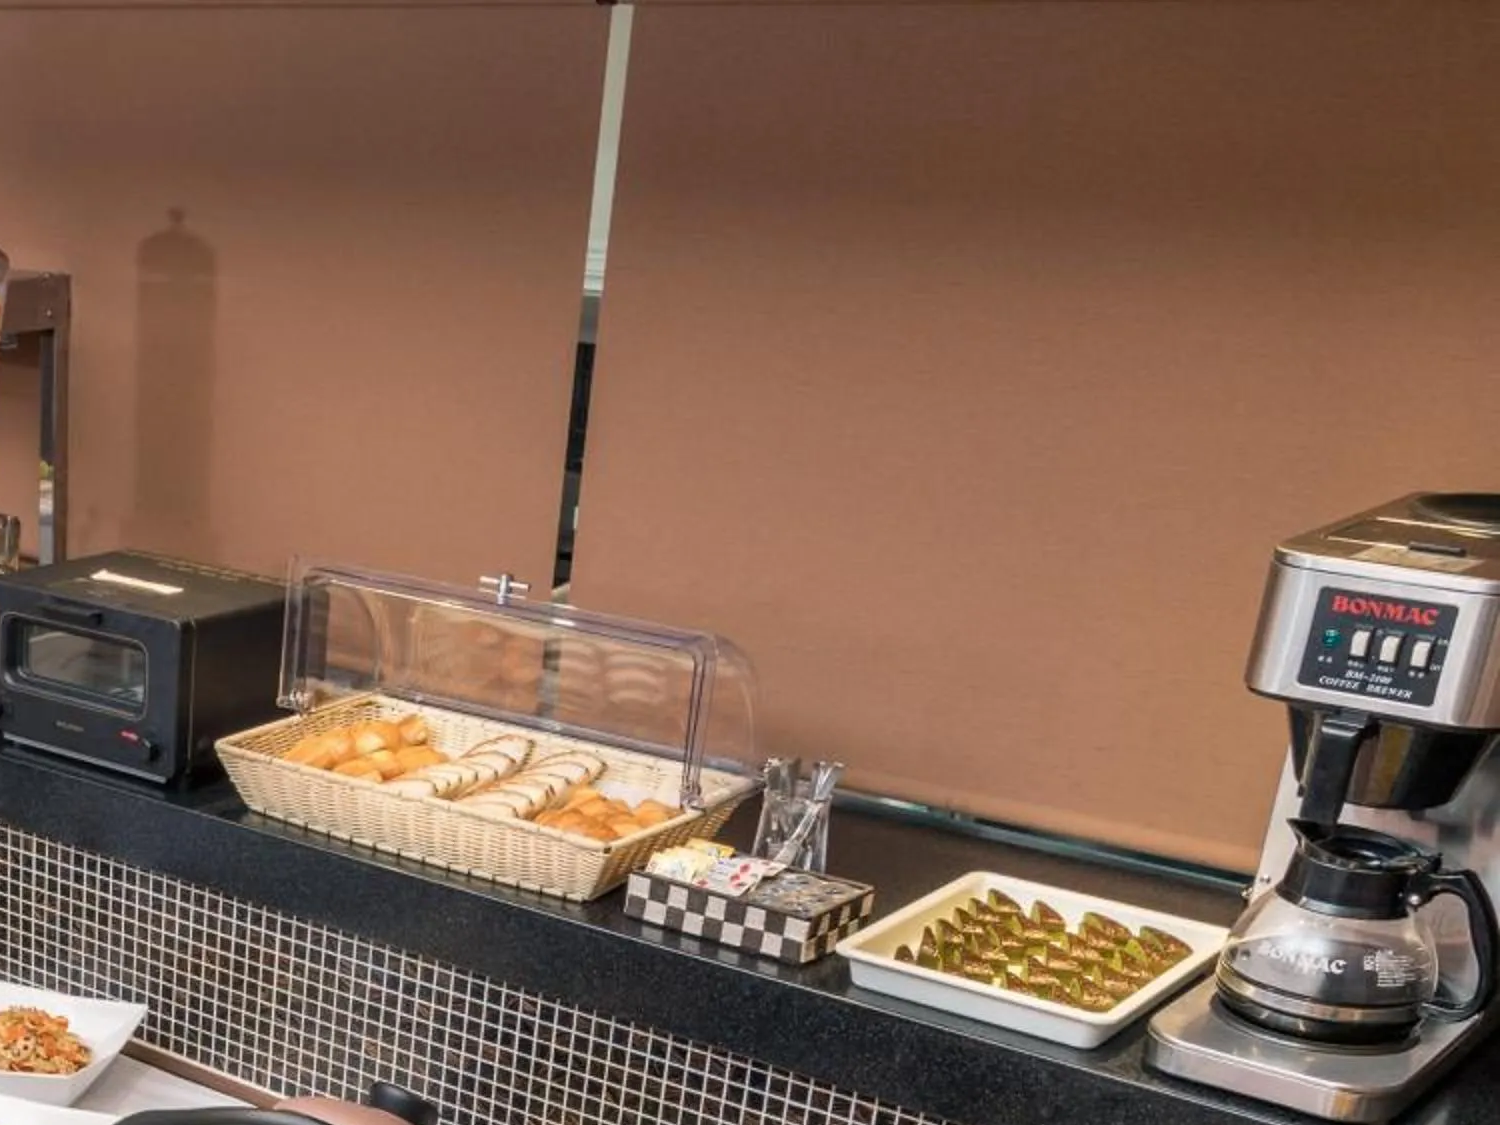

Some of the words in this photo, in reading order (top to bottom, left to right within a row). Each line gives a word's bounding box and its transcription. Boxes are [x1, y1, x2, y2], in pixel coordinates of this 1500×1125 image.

[1332, 595, 1438, 625] BONMAC
[1318, 675, 1360, 690] COFFEE
[1366, 682, 1413, 699] BREWER
